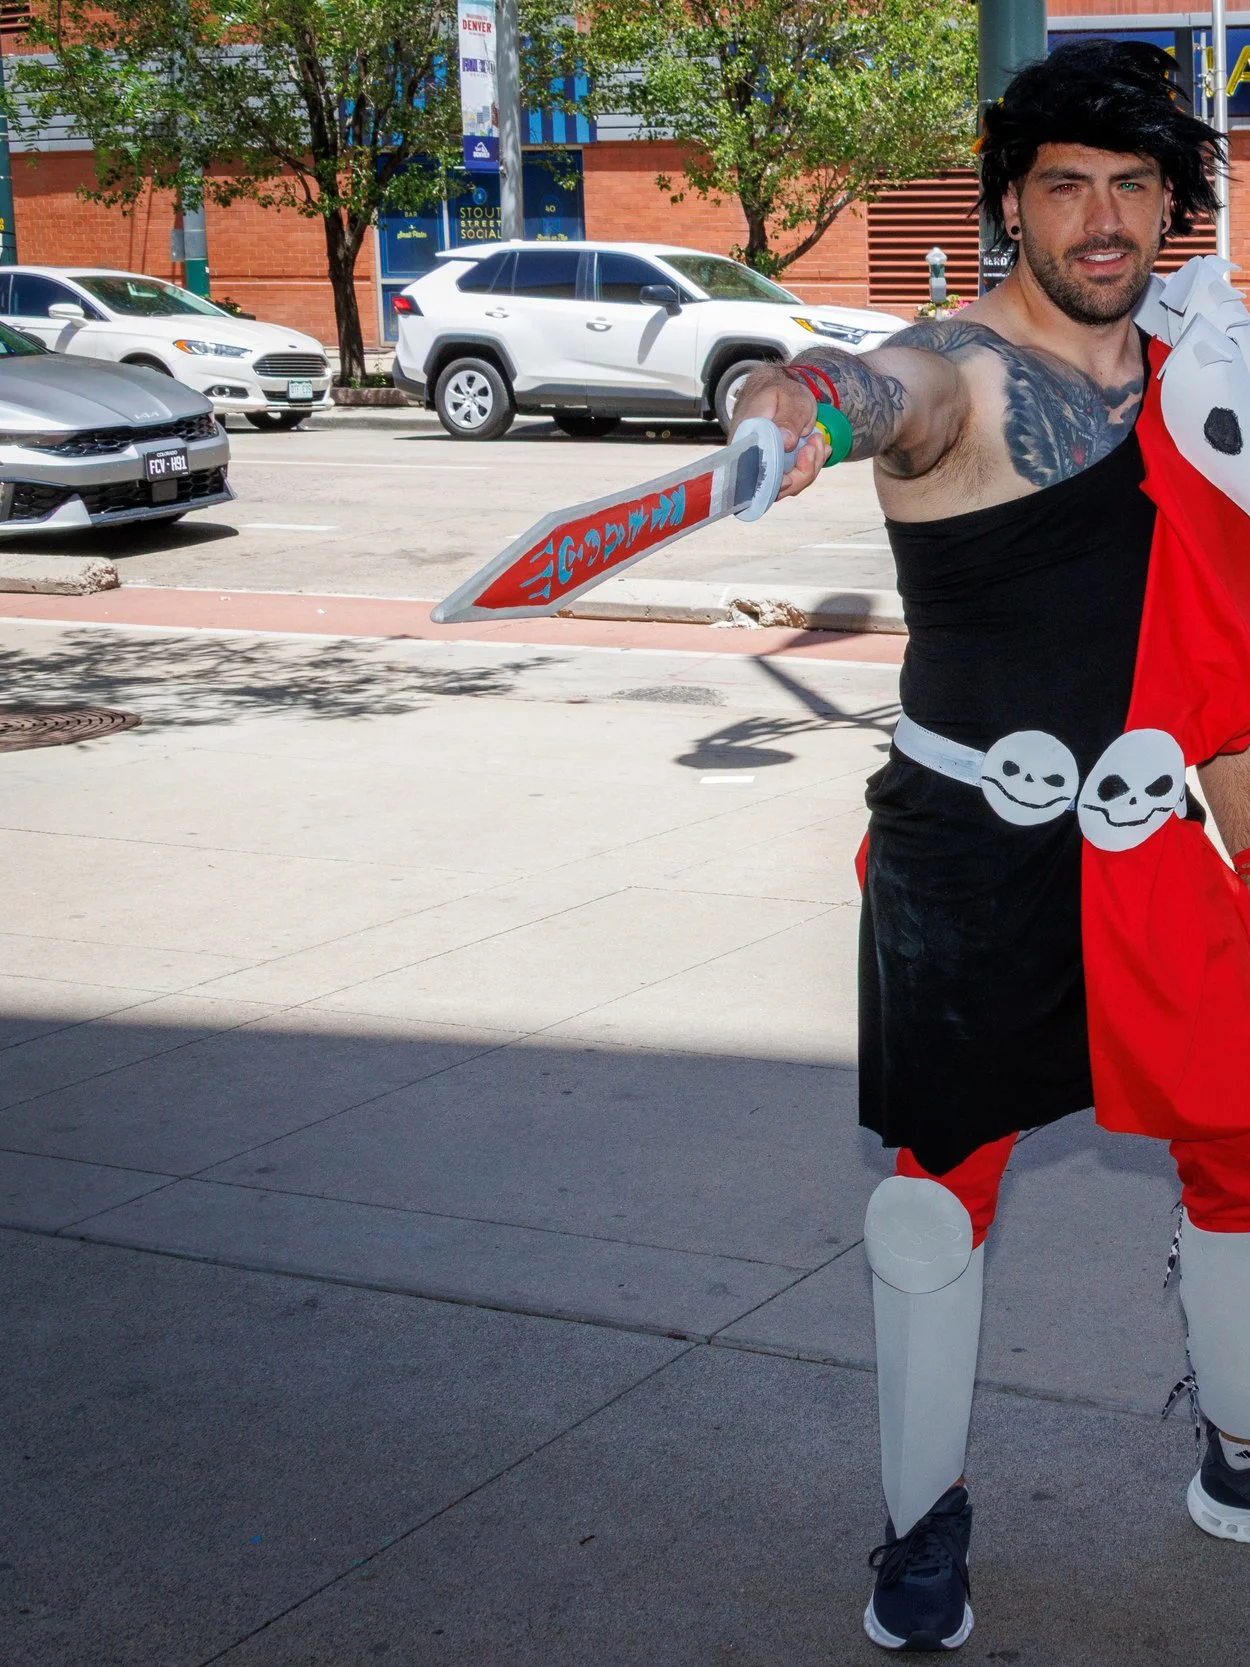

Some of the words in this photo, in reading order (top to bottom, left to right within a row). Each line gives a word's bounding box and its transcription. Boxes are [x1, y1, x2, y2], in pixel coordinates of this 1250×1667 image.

[462, 19, 492, 33] DENVER
[460, 207, 501, 218] STOUT
[461, 229, 502, 240] SOCIAL
